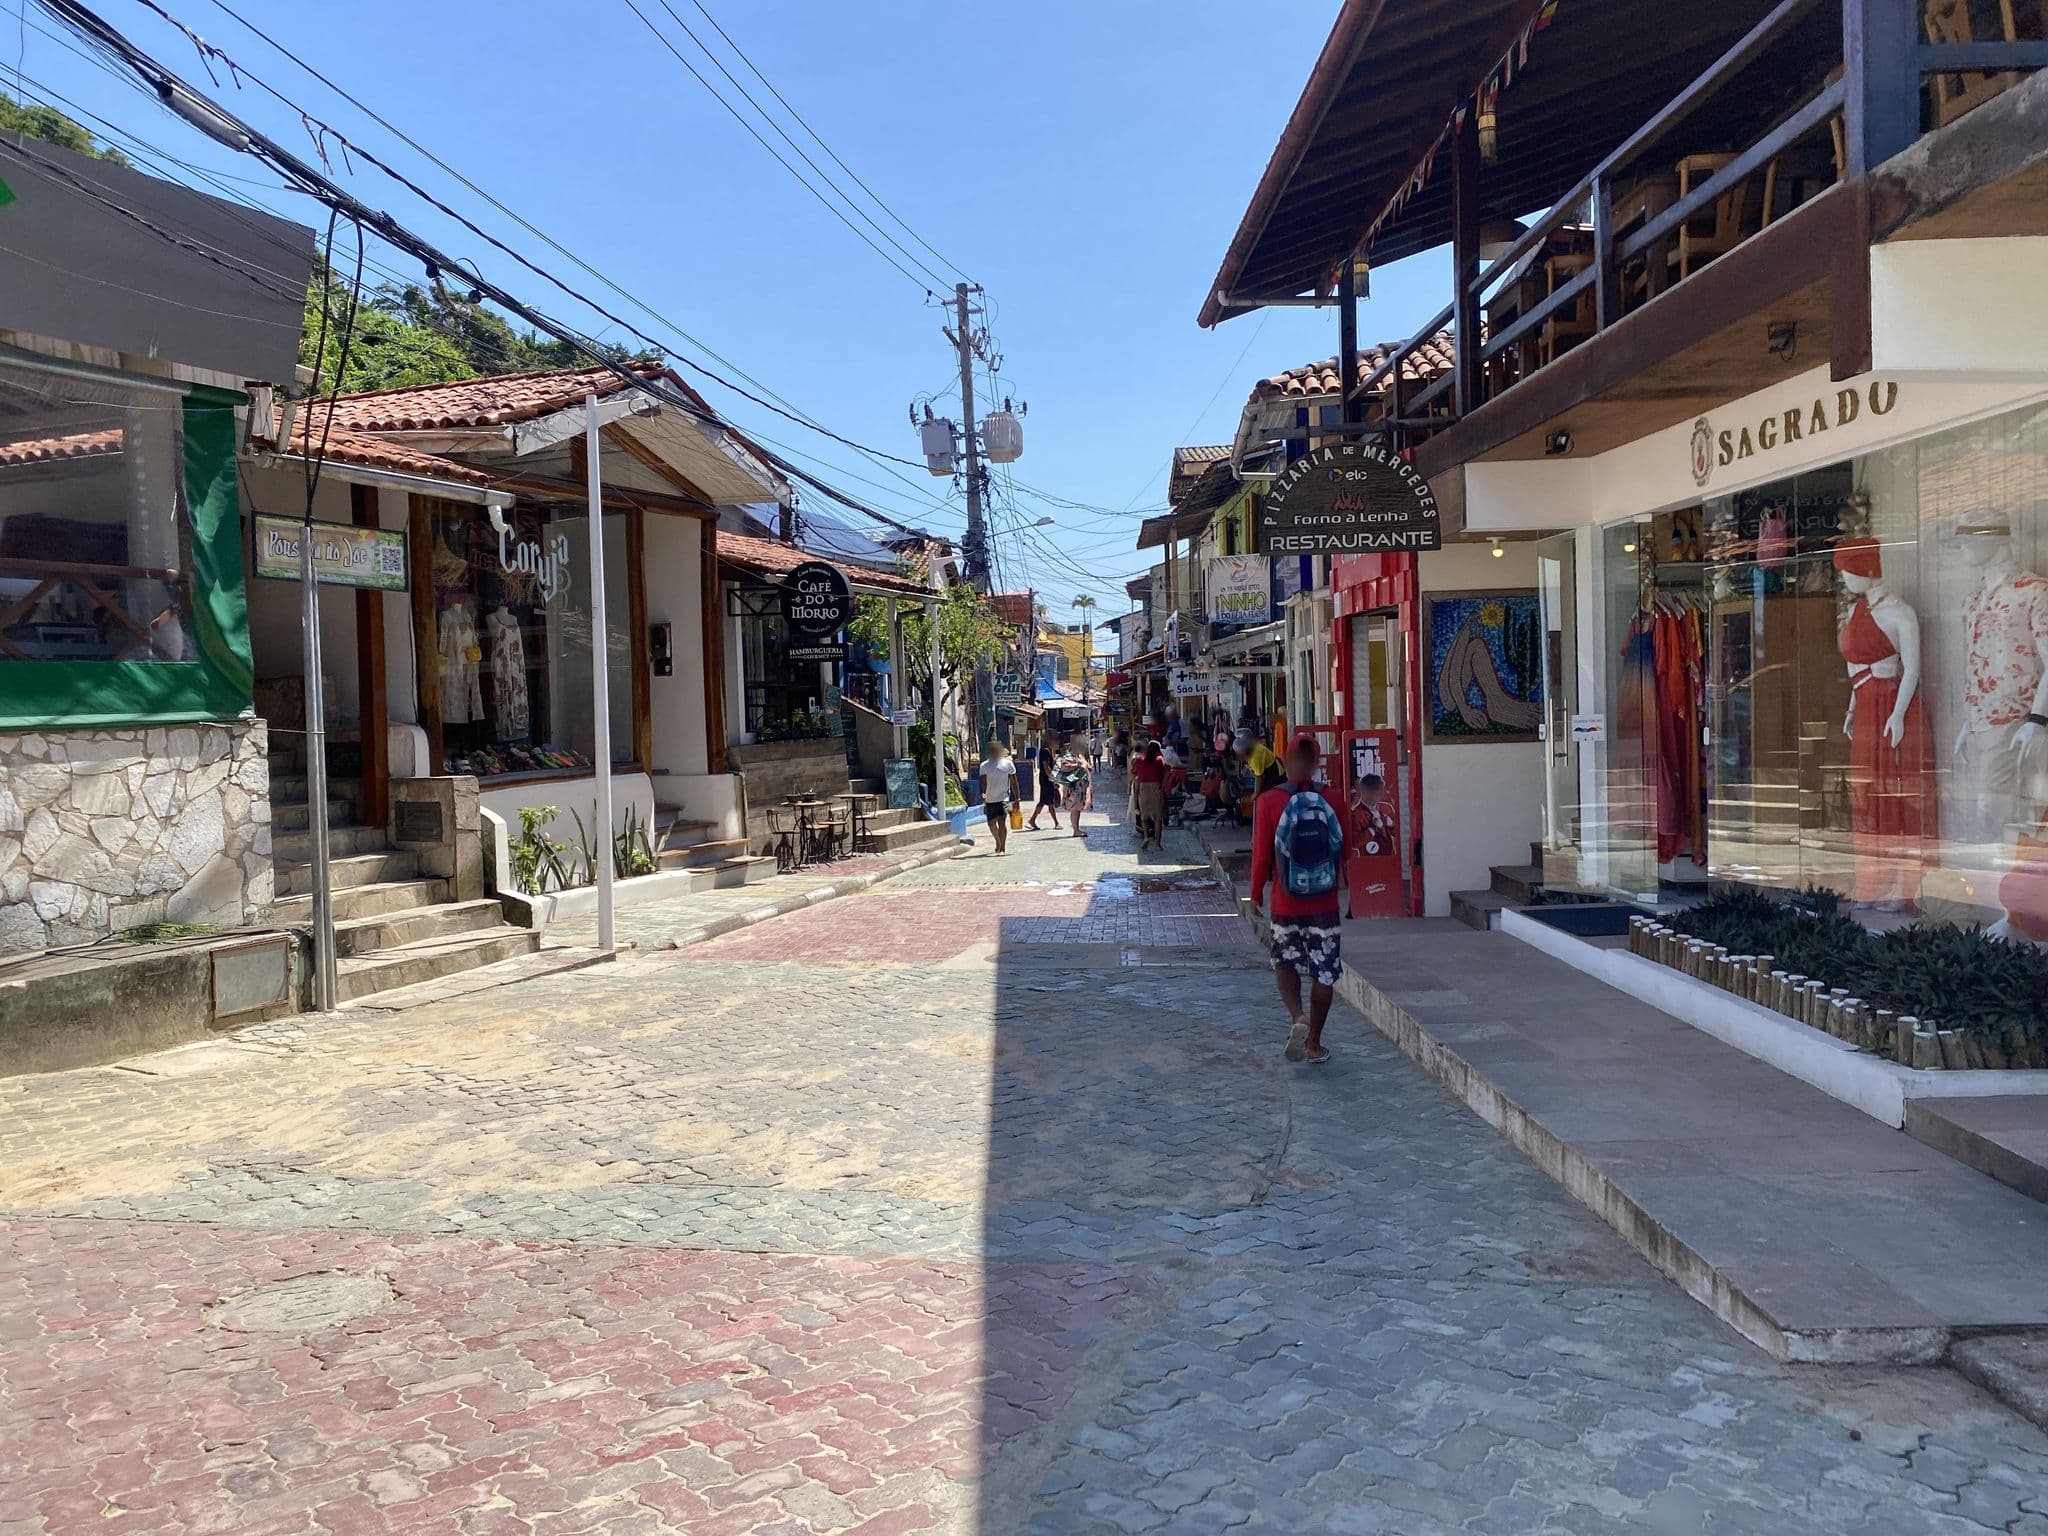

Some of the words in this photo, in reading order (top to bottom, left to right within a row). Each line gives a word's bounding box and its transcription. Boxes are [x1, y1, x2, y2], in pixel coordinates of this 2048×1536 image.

[1718, 382, 1898, 467] SAGRADO
[1264, 447, 1335, 525] PIZZARIA
[1343, 446, 1354, 455] DE
[1363, 445, 1437, 519] MERCEDES
[1294, 514, 1341, 525] Forno
[1360, 511, 1409, 523] Lenha
[1270, 531, 1433, 550] RESTAURANTE
[343, 537, 368, 567] Joe
[499, 524, 570, 602] Coruja
[798, 579, 832, 593] CAFÉ
[805, 594, 825, 605] DO
[1219, 591, 1267, 612] NINHO
[791, 606, 840, 620] MORRO
[789, 647, 843, 656] HAMBURGUERIA
[1176, 684, 1194, 694] São
